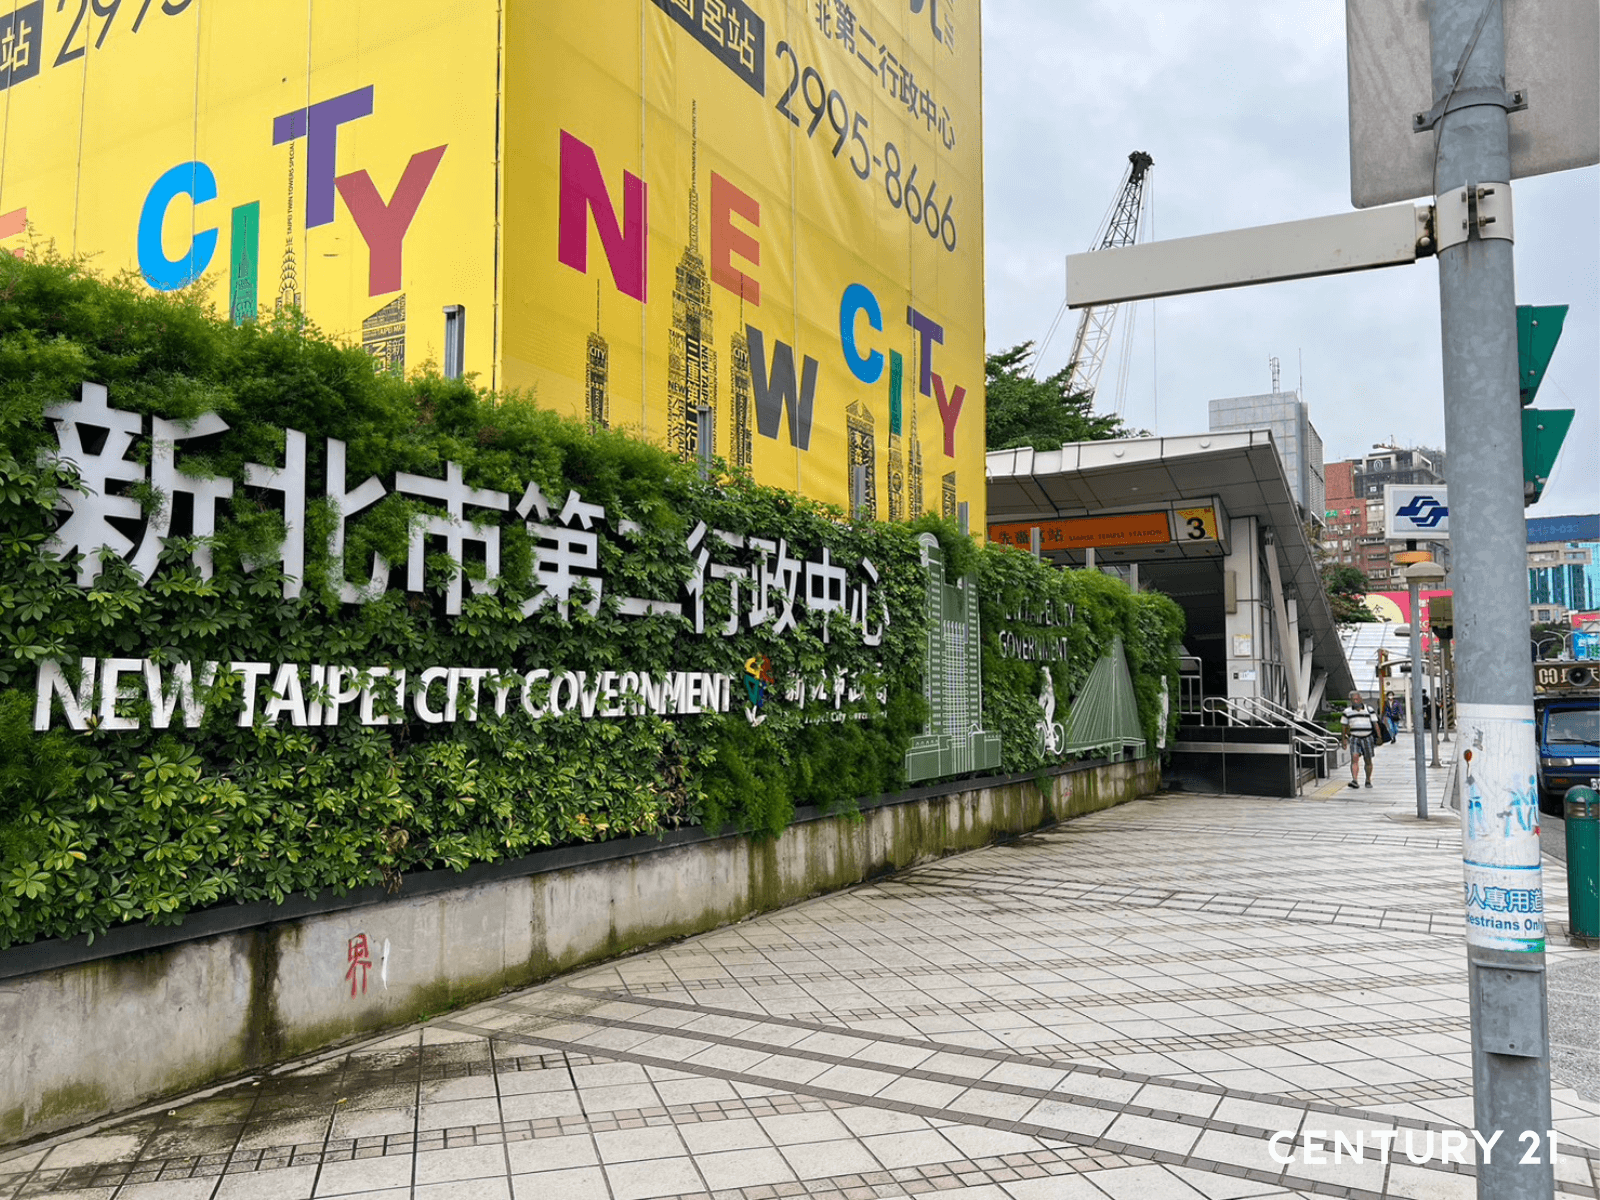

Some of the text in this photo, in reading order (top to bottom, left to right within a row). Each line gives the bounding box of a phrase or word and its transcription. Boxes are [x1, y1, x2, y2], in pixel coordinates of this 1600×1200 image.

[775, 40, 957, 252] 2995-8666
[806, 0, 956, 150] 北第二行政中心
[137, 84, 448, 320] CITY
[557, 128, 818, 450] NEW
[839, 282, 967, 459] CITY
[701, 375, 710, 406] TAIPE
[38, 381, 890, 647] 新北市第二行政中心
[1186, 517, 1206, 540] 3
[34, 656, 735, 732] NEW TAIPEI CITY GOVERNMENT
[1464, 883, 1544, 913] 人專用道
